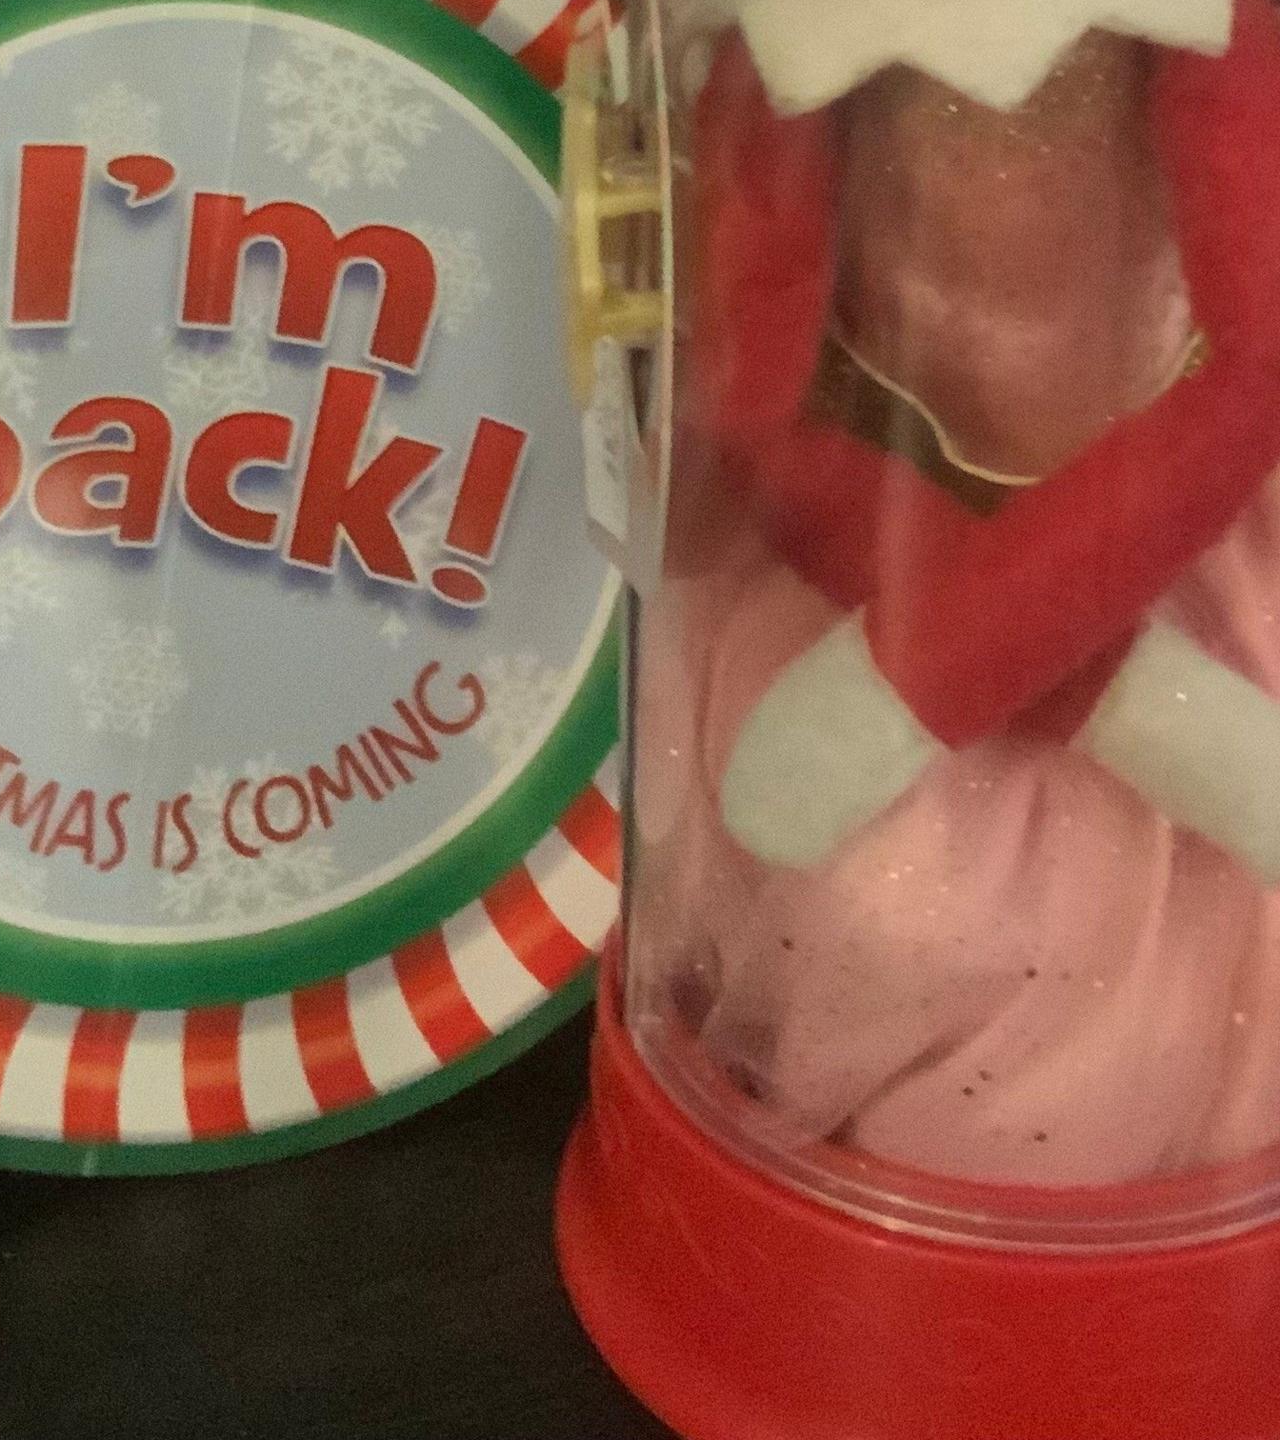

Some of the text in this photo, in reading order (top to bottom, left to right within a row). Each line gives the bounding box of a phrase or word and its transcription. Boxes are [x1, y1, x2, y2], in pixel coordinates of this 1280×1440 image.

[9, 144, 437, 372] I'm
[152, 794, 199, 872] IS
[223, 662, 486, 858] COMING
